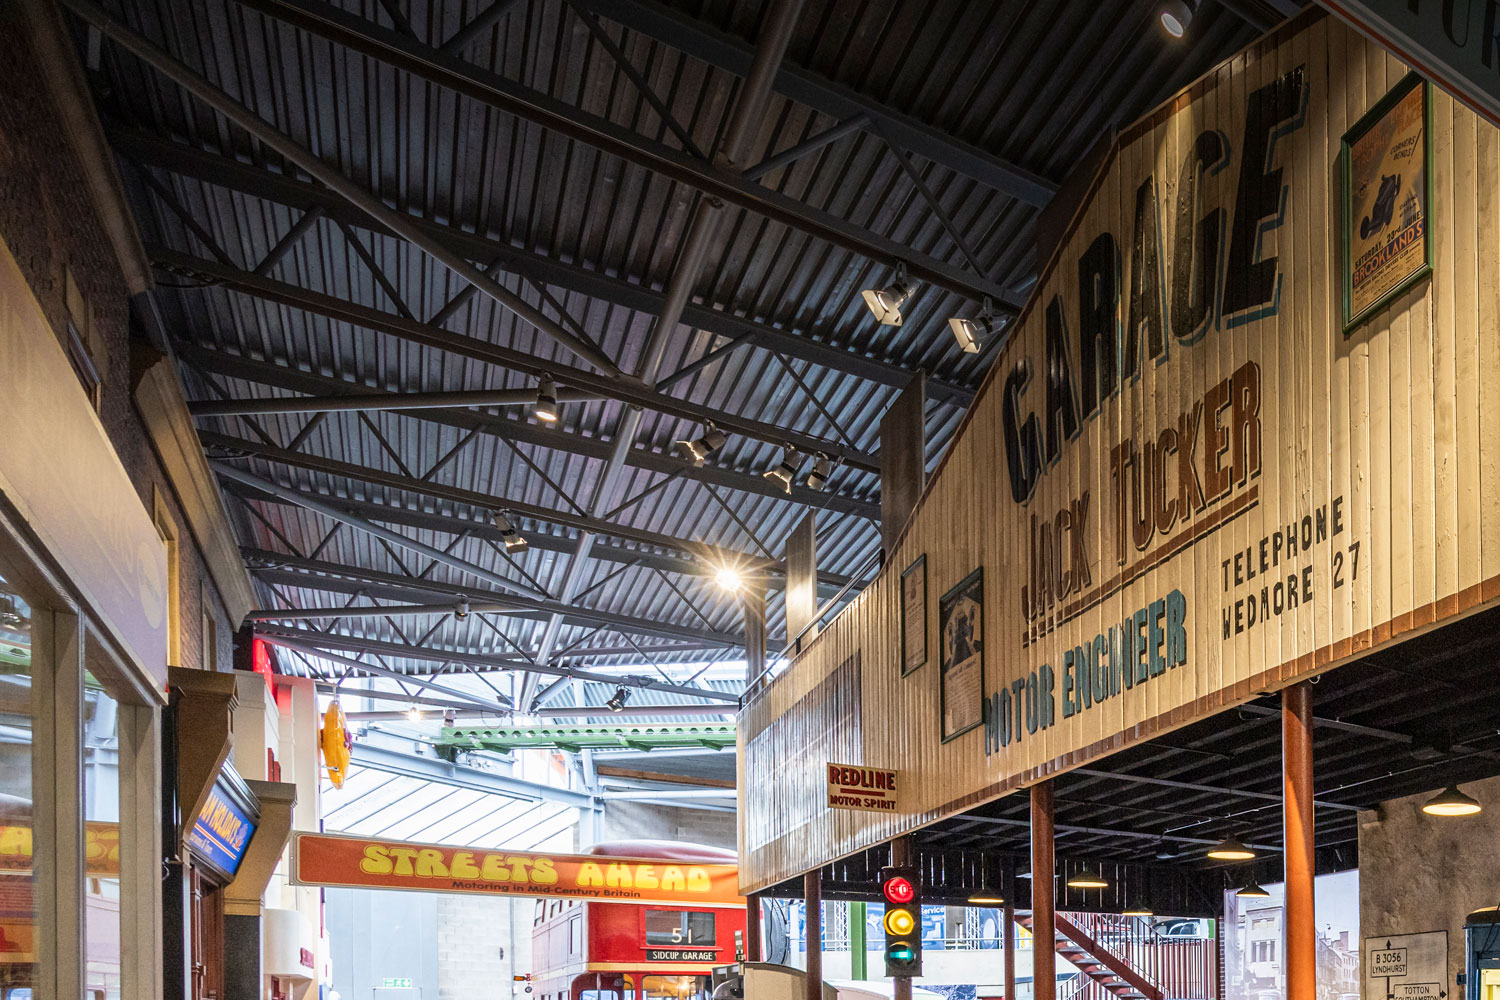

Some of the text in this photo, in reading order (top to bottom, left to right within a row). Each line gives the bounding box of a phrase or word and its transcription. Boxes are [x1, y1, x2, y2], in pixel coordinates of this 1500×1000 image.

[1405, 210, 1421, 231] JUNE
[1353, 224, 1423, 287] BROOKLANDS
[1003, 64, 1310, 507] GARAGE
[1022, 490, 1092, 625] JACK
[1110, 360, 1262, 566] TUCKER
[1222, 494, 1344, 594] TELEPHONE
[1223, 540, 1361, 642] WEDMORE 27
[985, 663, 1056, 758] MOTOR
[1062, 588, 1188, 720] ENGINEER
[829, 765, 896, 791] REDLINE
[829, 794, 896, 811] MOTOR SPIRIT
[360, 845, 711, 894] STREETS AHEAD
[452, 881, 641, 899] Motoring in Mid-Century Britain
[890, 884, 913, 894] STOP
[671, 927, 692, 944] 51
[652, 951, 713, 960] SIDCUP GARAGE
[1376, 952, 1402, 964] B 3056
[1372, 964, 1406, 974] LYNDHURST
[1404, 986, 1430, 995] TOTTON
